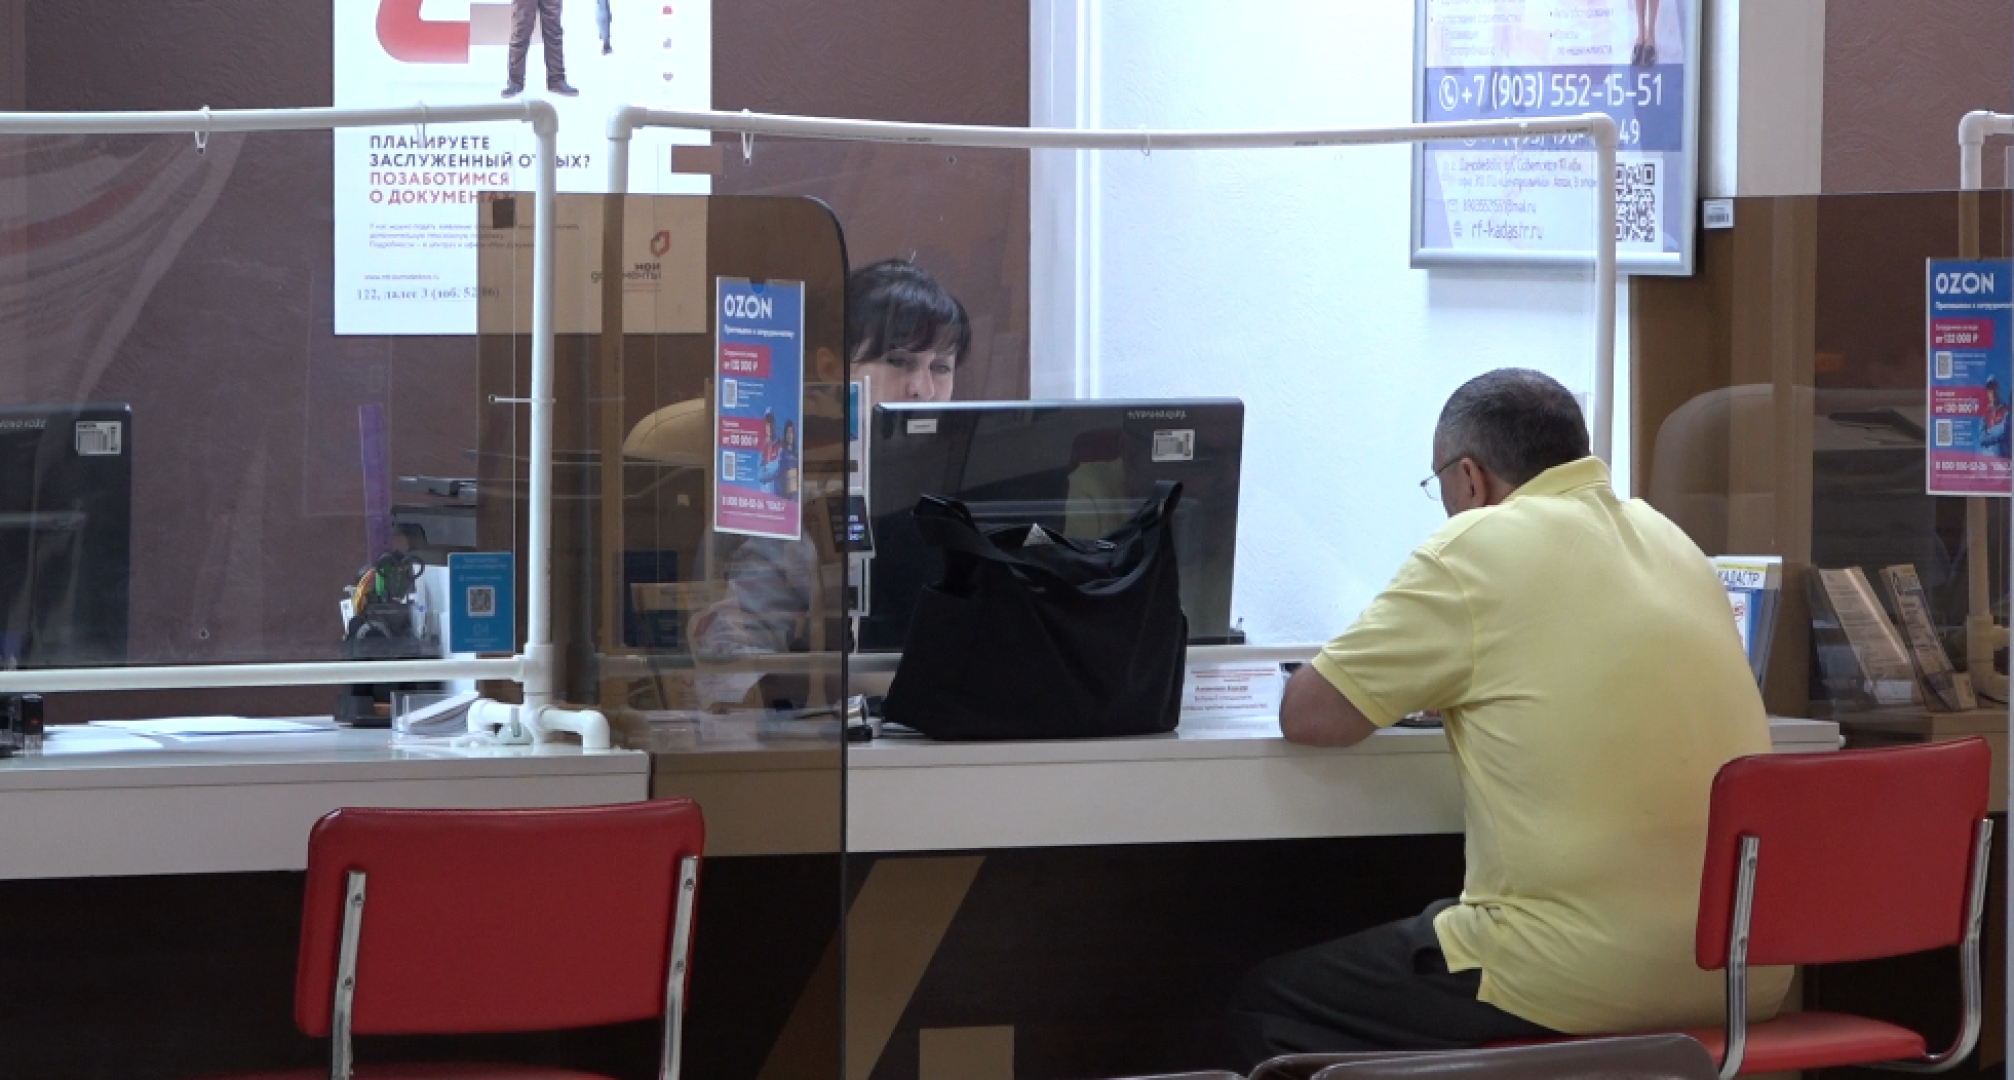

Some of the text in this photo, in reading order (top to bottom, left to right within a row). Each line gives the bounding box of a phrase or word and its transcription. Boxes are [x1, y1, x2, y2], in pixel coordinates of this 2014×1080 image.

[1461, 72, 1662, 110] +7 (903) 552-15-51
[369, 135, 490, 149] ПЛАНИРУЕТЕ
[369, 152, 591, 168] ЗАСЛУЖЕННЫЙ ОЫХ?
[369, 172, 510, 186] ПОЗАБОТИМСЯ
[369, 190, 384, 204] О
[1935, 272, 1995, 295] OZON
[723, 295, 773, 319] OZON
